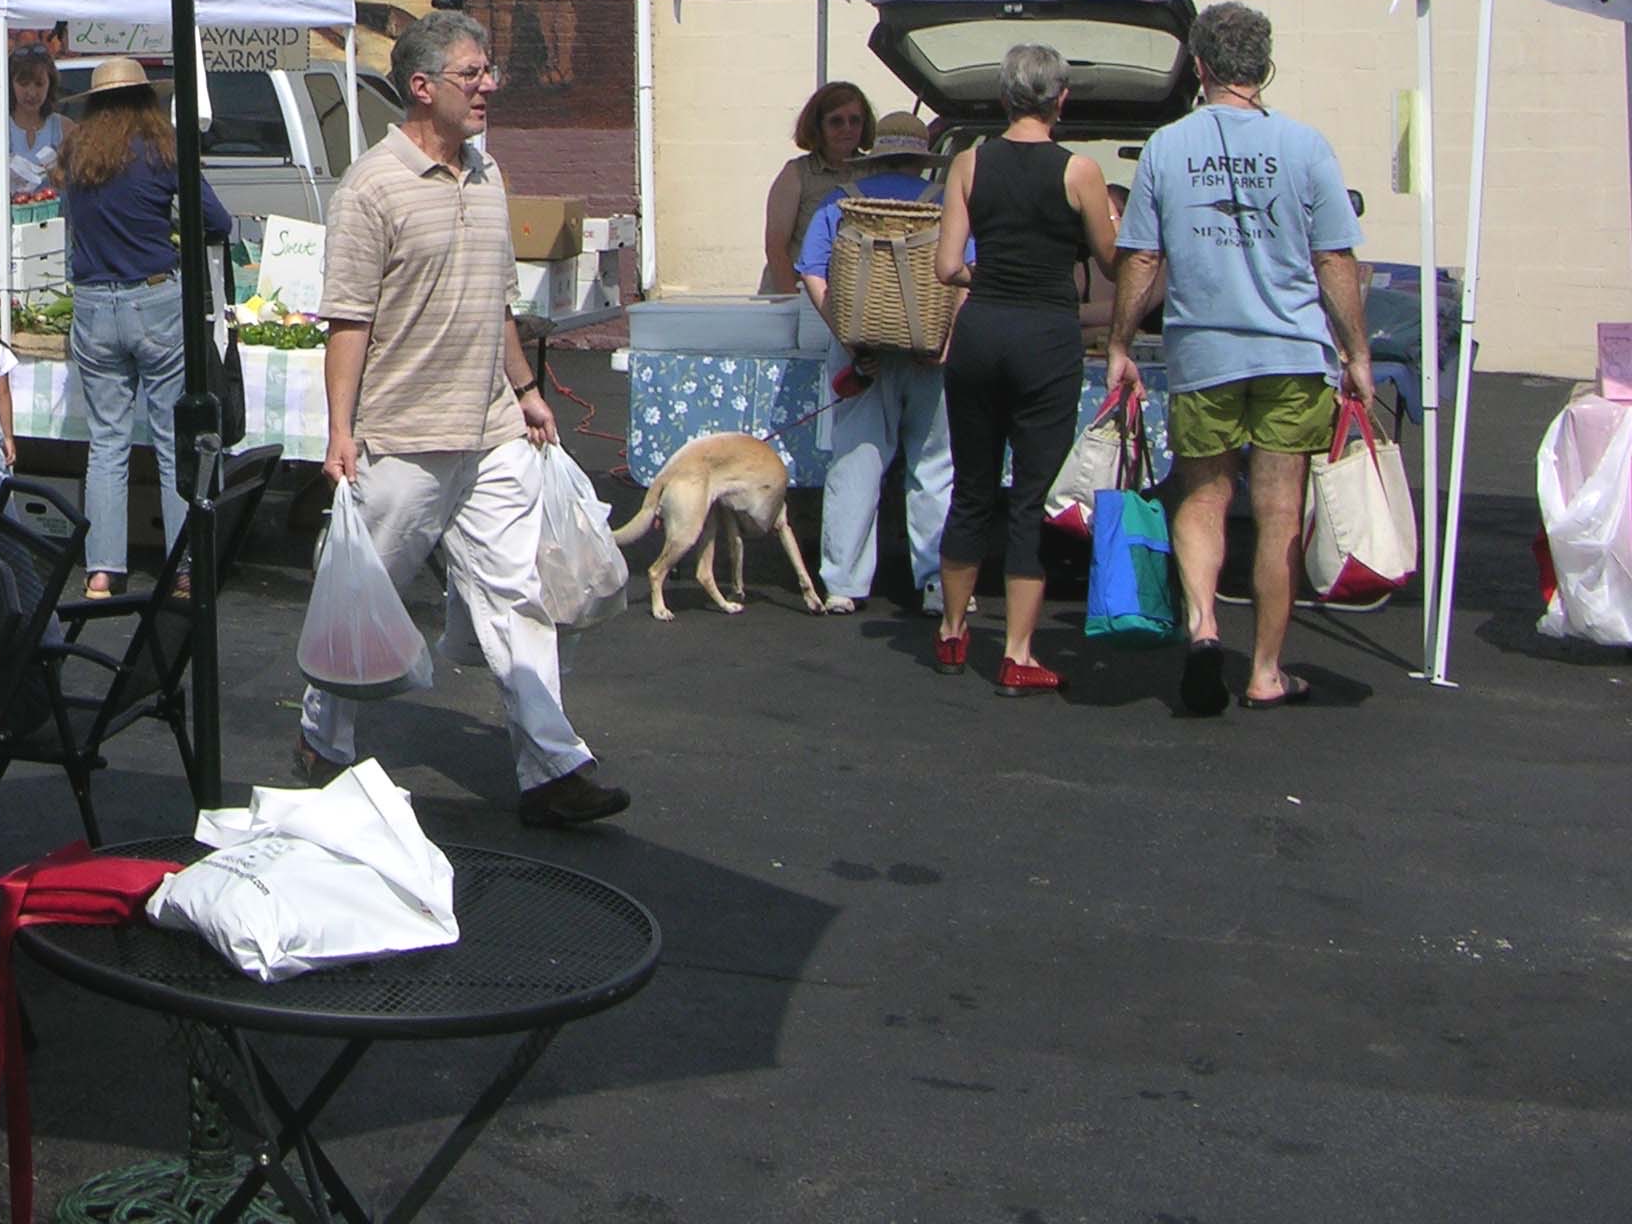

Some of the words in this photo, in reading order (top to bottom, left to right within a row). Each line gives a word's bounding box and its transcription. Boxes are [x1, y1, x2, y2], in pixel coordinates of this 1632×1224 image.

[201, 27, 299, 45] AYNARD
[1192, 174, 1225, 187] FISH
[1229, 176, 1274, 189] ARKET
[1192, 226, 1276, 240] MENESHA
